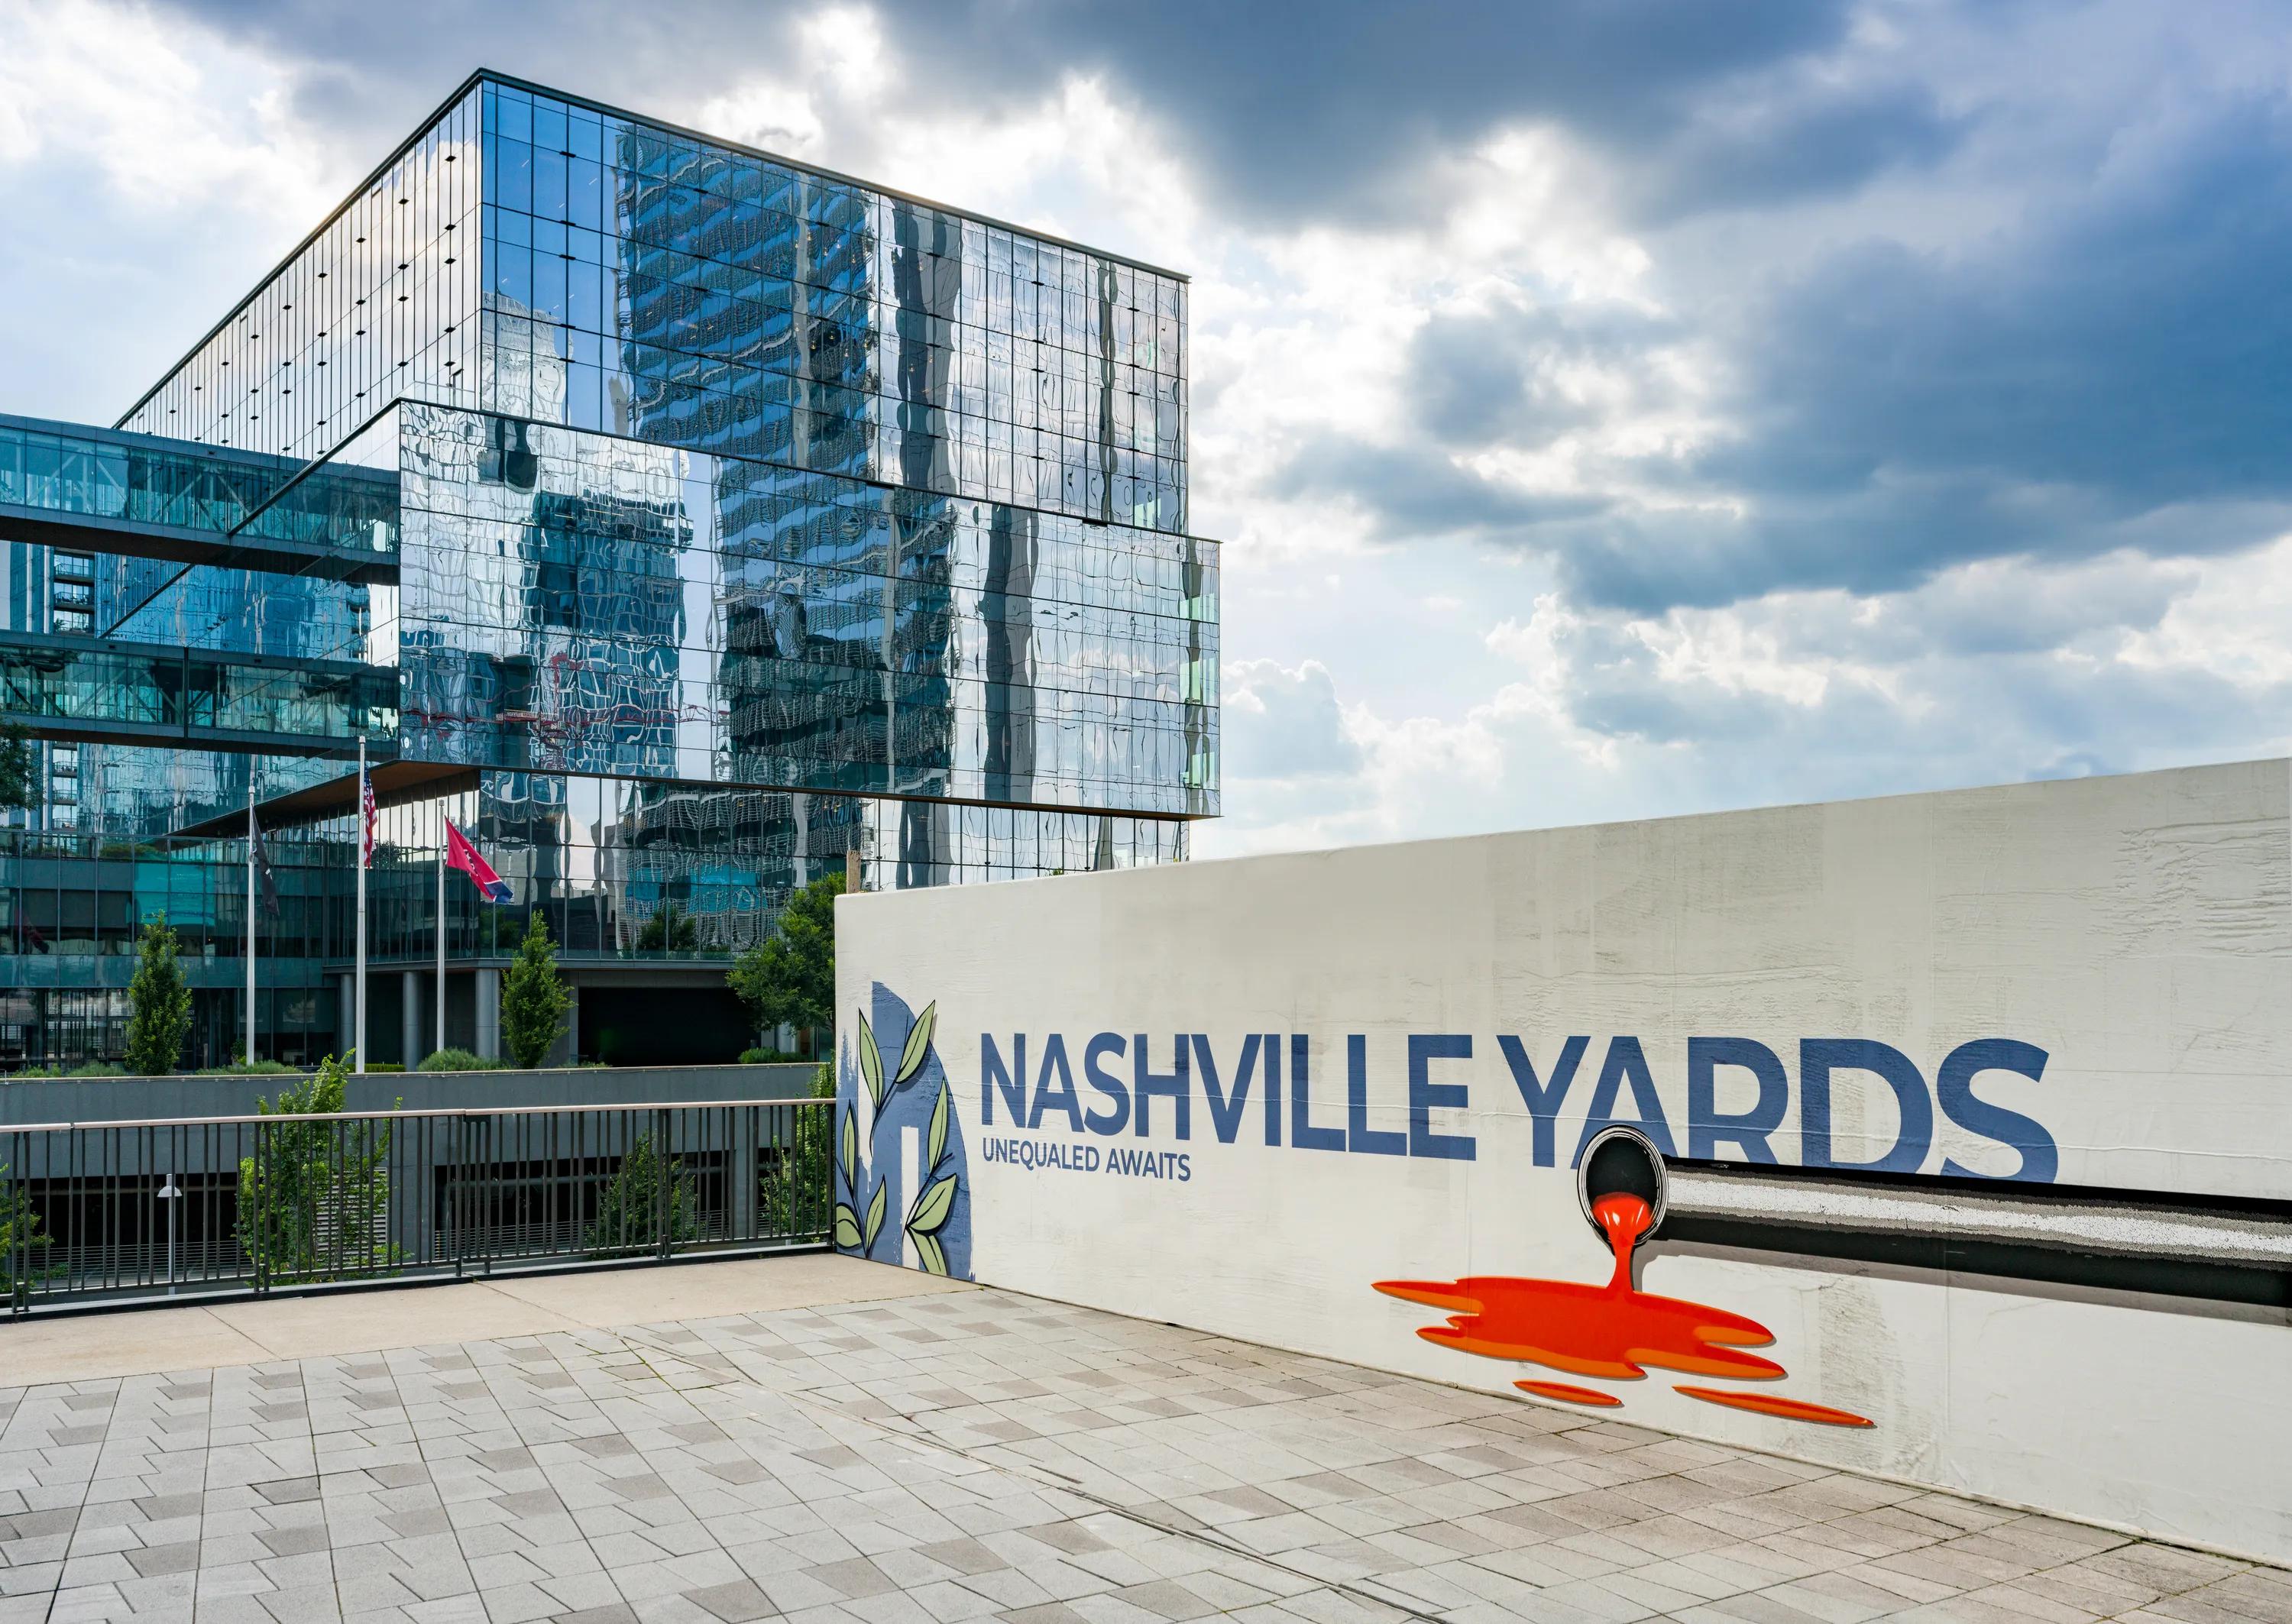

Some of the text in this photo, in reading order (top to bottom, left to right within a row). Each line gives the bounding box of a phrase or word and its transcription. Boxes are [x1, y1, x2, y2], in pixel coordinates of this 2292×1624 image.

[981, 1032, 2059, 1184] NASHVILLE YARDS
[983, 1137, 1192, 1182] UNEQUALED AWAITS
